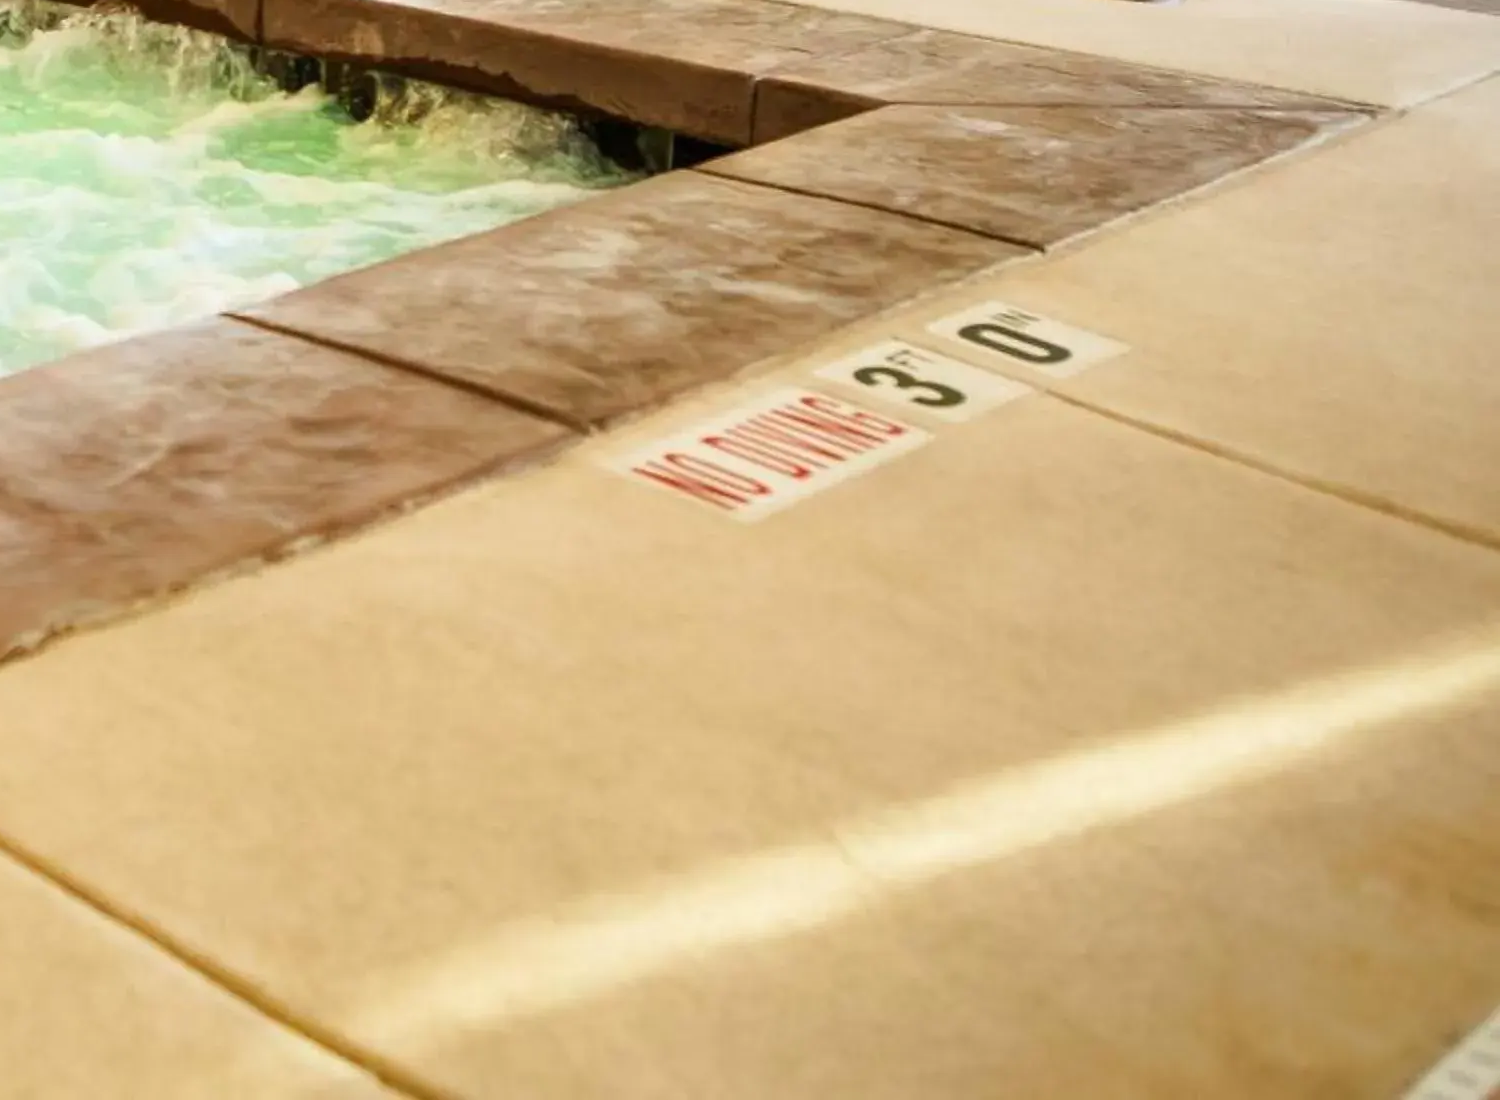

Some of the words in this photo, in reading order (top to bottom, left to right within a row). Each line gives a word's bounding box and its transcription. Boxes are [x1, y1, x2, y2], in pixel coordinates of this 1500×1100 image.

[884, 349, 936, 373] FT
[957, 323, 1073, 365] 0
[853, 366, 967, 408] 3
[700, 396, 905, 480] DIVING
[631, 452, 772, 511] NO
